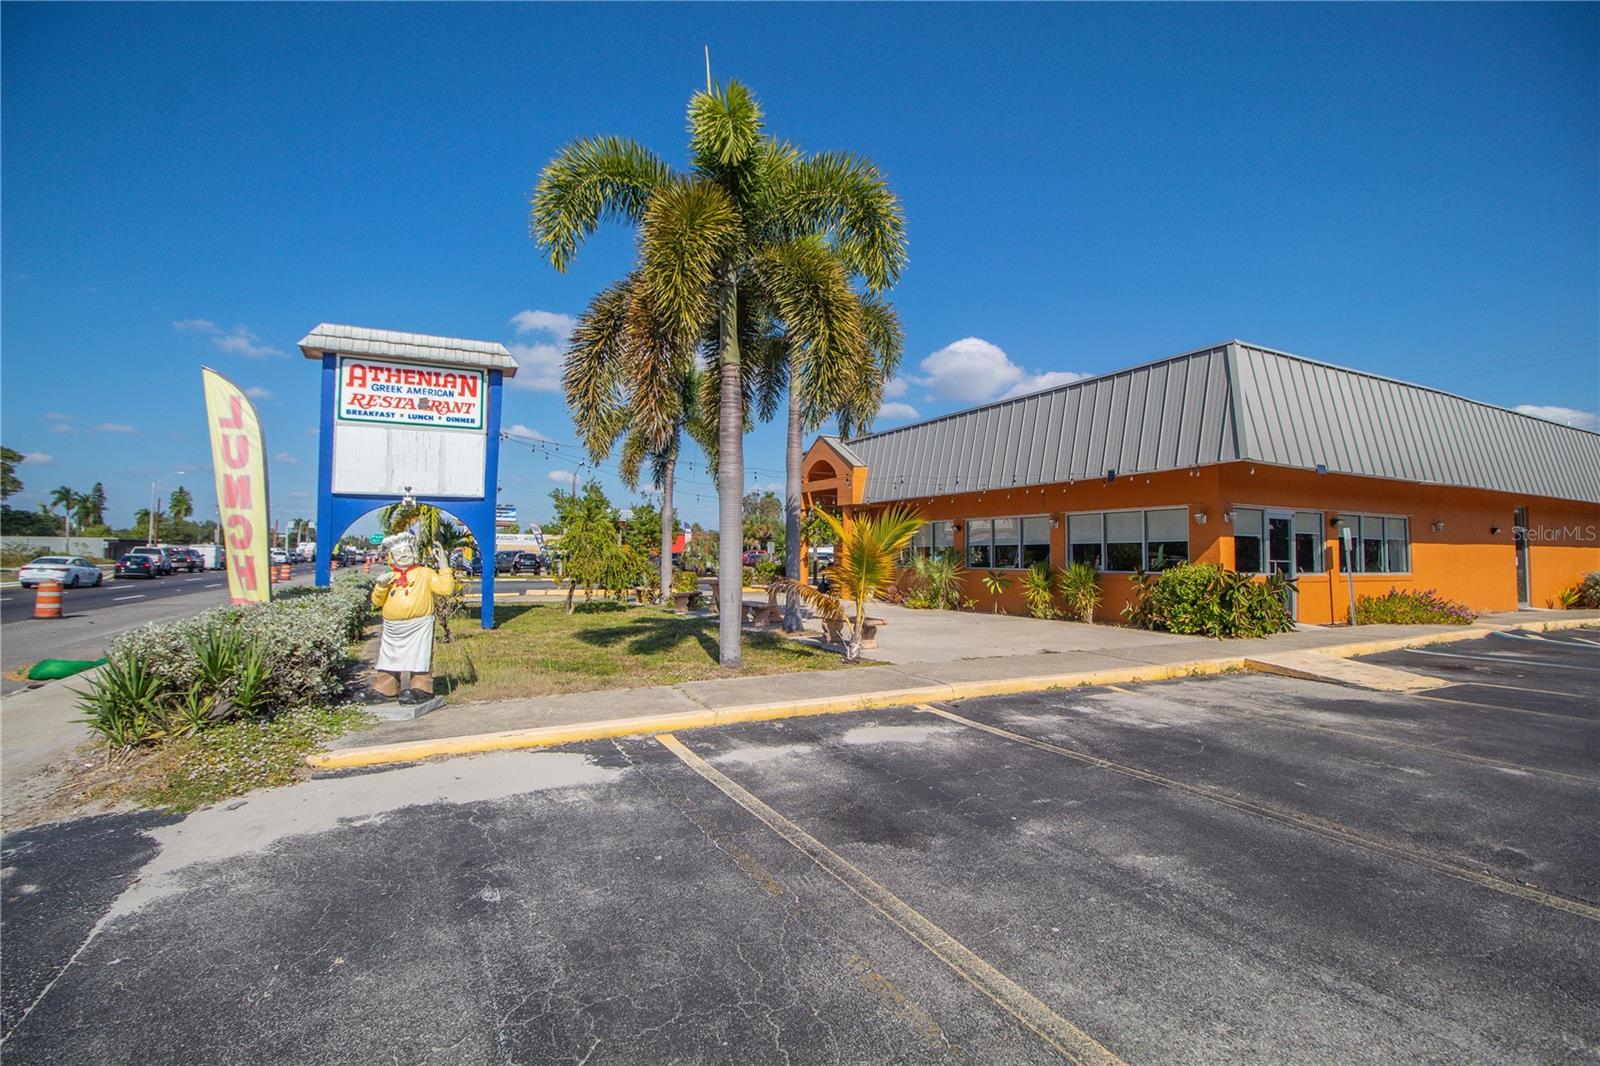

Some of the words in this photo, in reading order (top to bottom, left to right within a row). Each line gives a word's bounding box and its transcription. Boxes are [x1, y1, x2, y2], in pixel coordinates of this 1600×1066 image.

[345, 362, 478, 398] ATHENIAN
[371, 383, 403, 394] GREEK
[406, 387, 455, 398] AMERICAN
[347, 392, 476, 416] RESTARANT
[345, 408, 396, 419] BREAKFAST
[407, 413, 434, 422] LUNCH
[446, 416, 476, 425] DINNER
